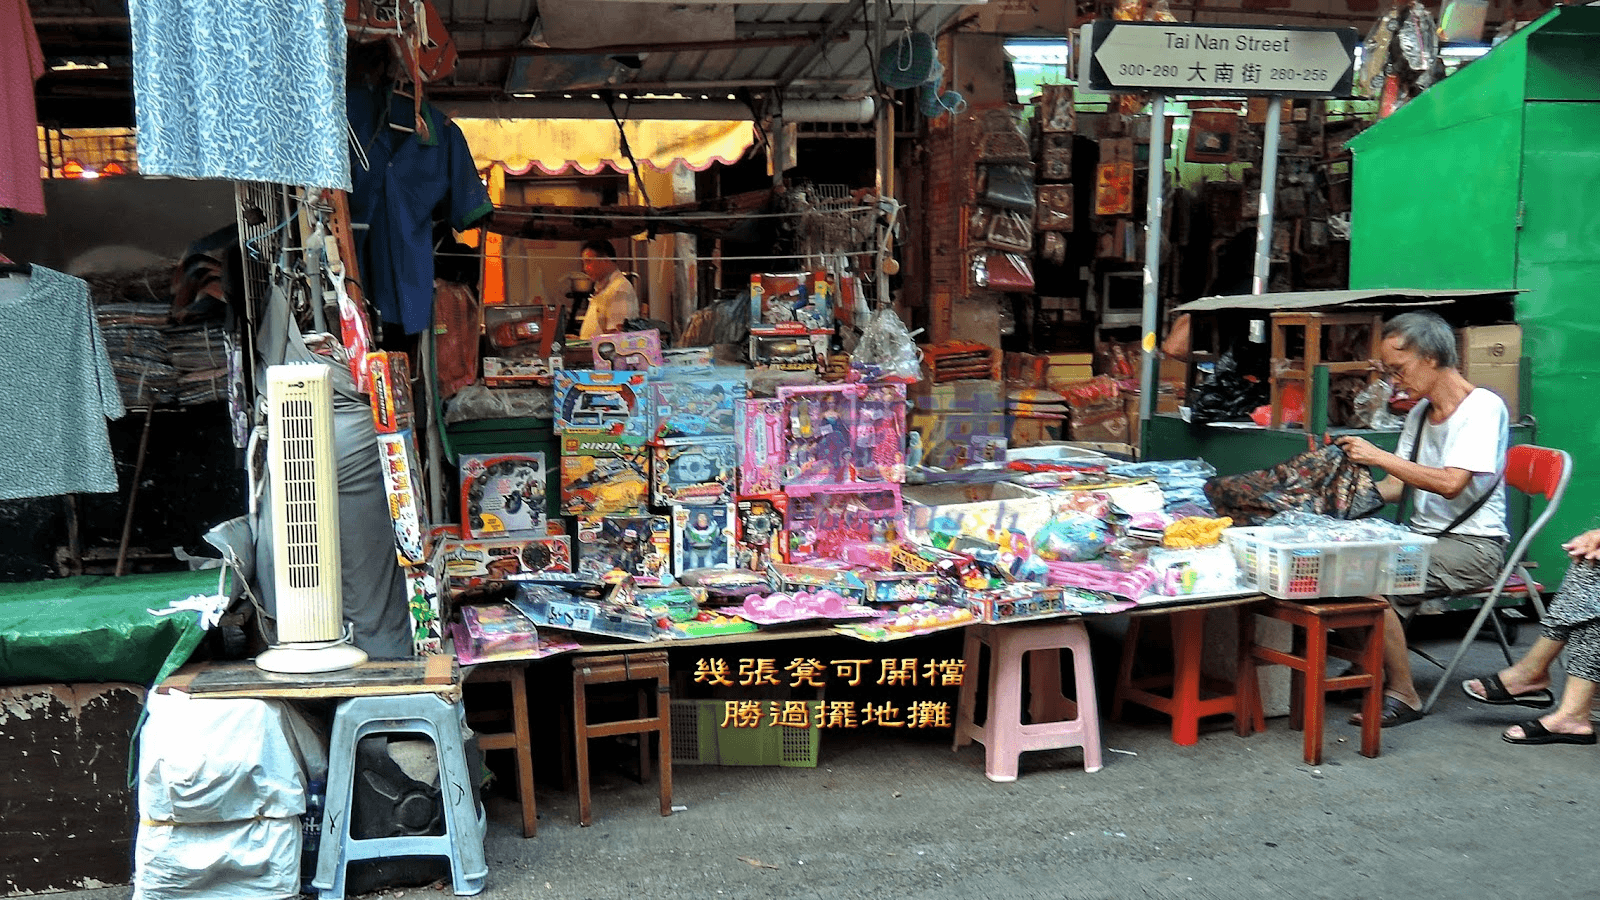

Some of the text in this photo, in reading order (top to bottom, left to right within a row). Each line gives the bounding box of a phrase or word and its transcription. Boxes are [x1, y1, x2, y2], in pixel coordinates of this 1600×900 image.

[1164, 32, 1290, 52] Tai Nan Street
[1119, 63, 1178, 77] 300-280
[1186, 61, 1262, 83] 大南街
[580, 442, 622, 451] NINJA
